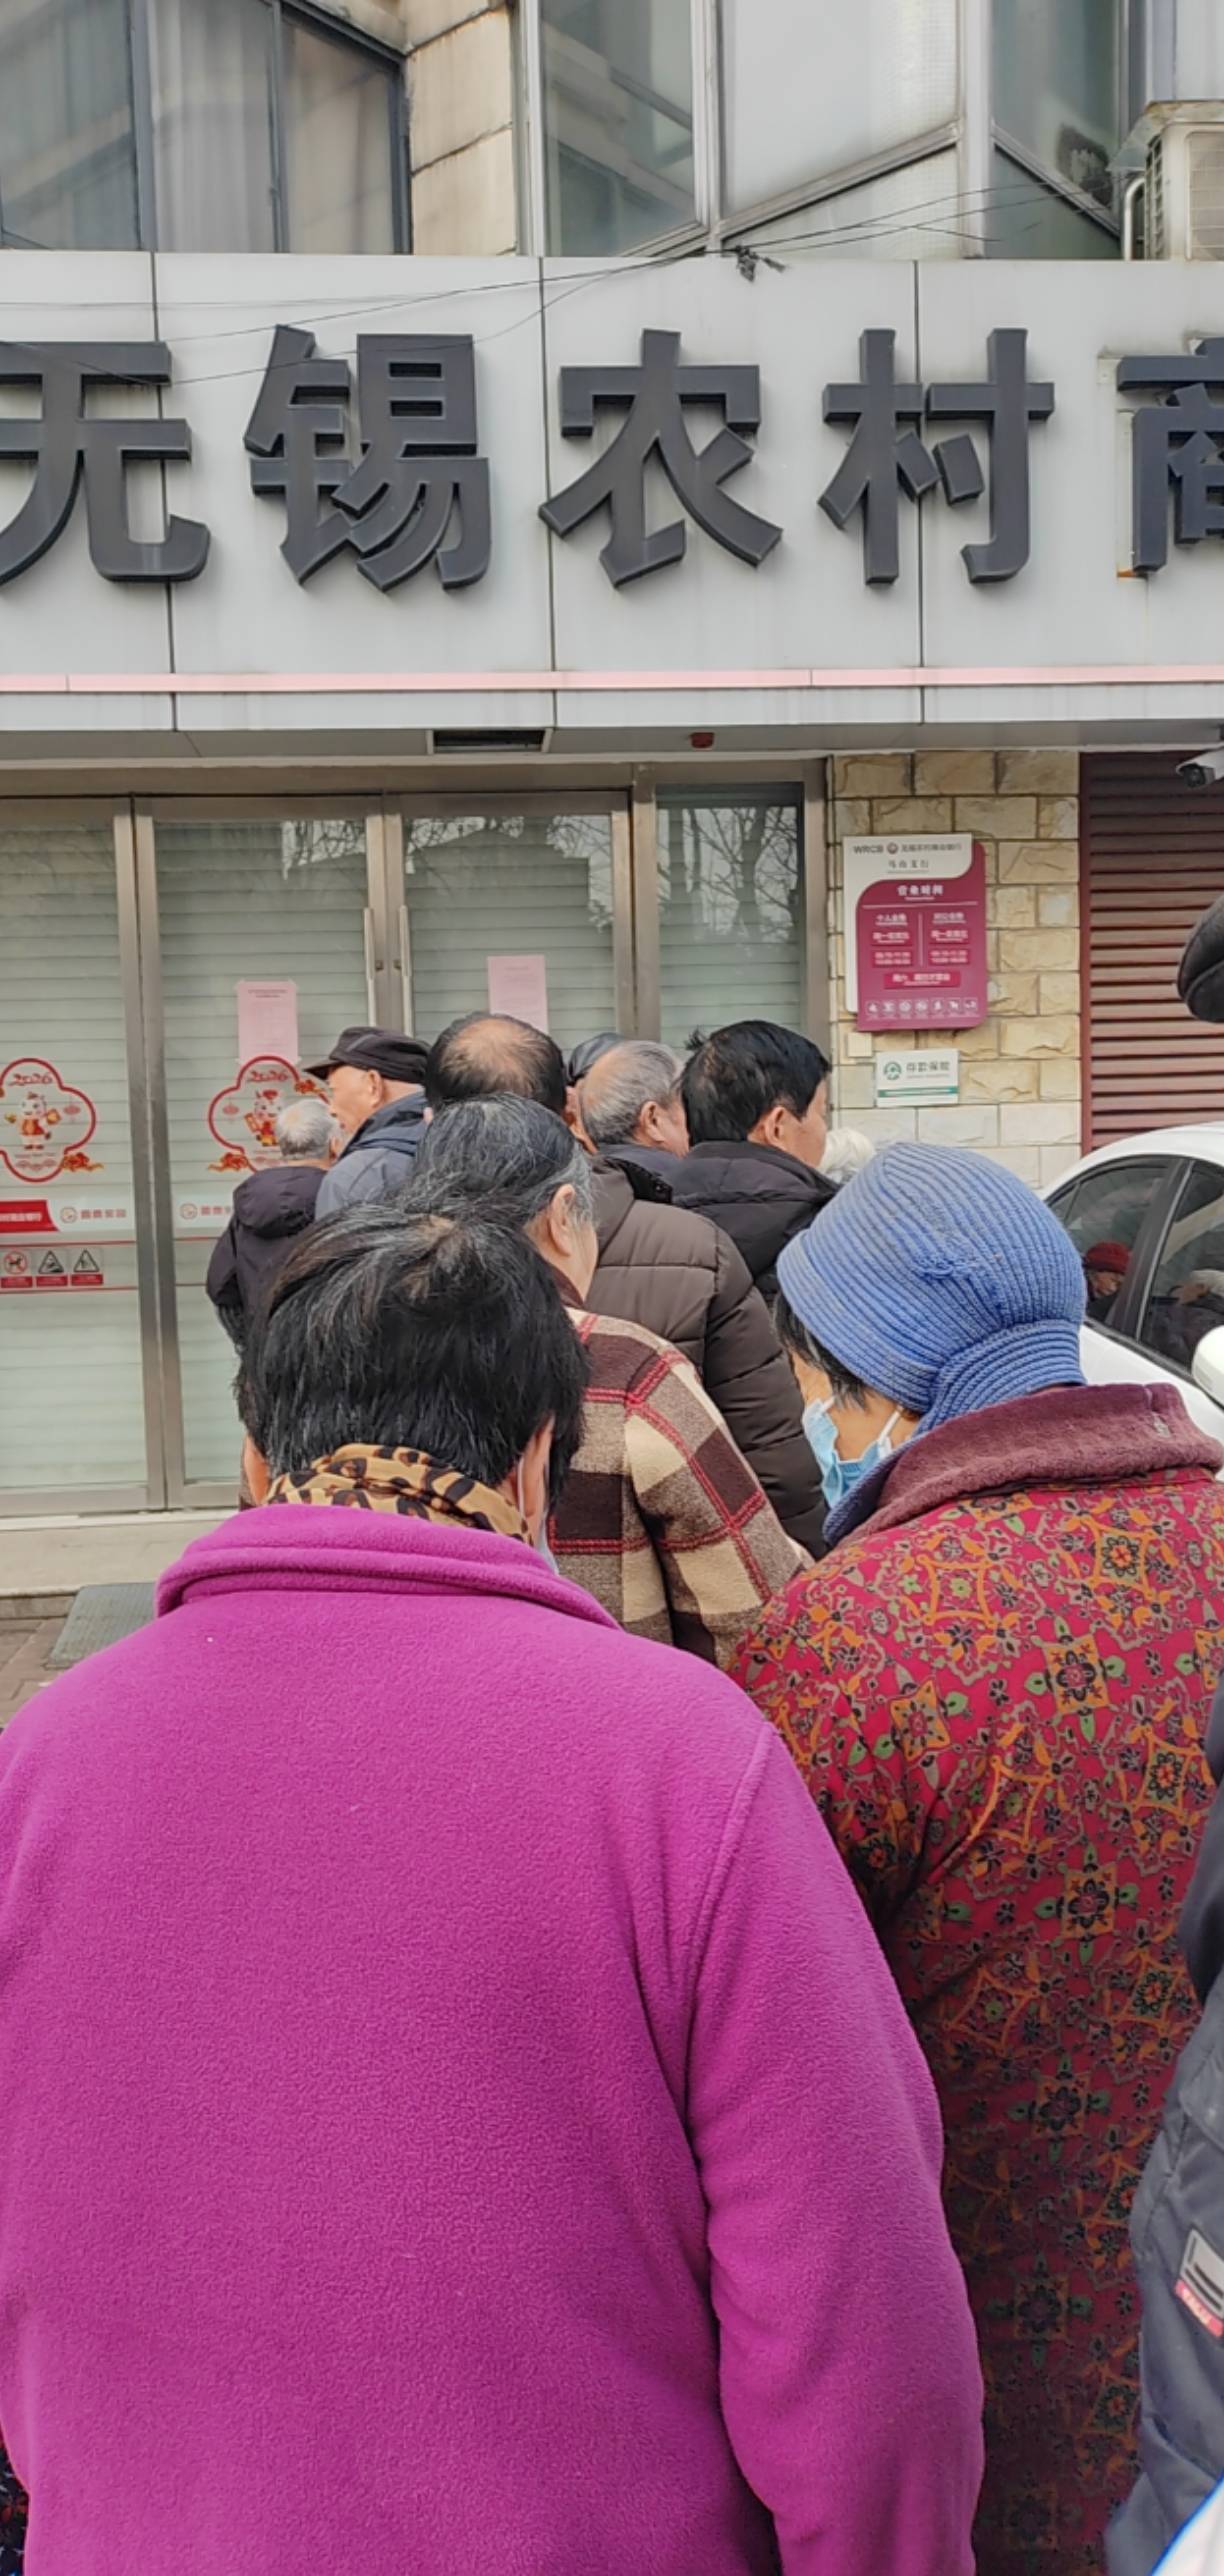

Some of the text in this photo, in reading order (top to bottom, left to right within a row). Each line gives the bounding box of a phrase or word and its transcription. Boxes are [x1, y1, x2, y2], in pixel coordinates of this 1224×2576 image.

[853, 845, 884, 855] WRCB
[897, 885, 944, 896] 营业时间
[8, 1072, 53, 1086] 2026
